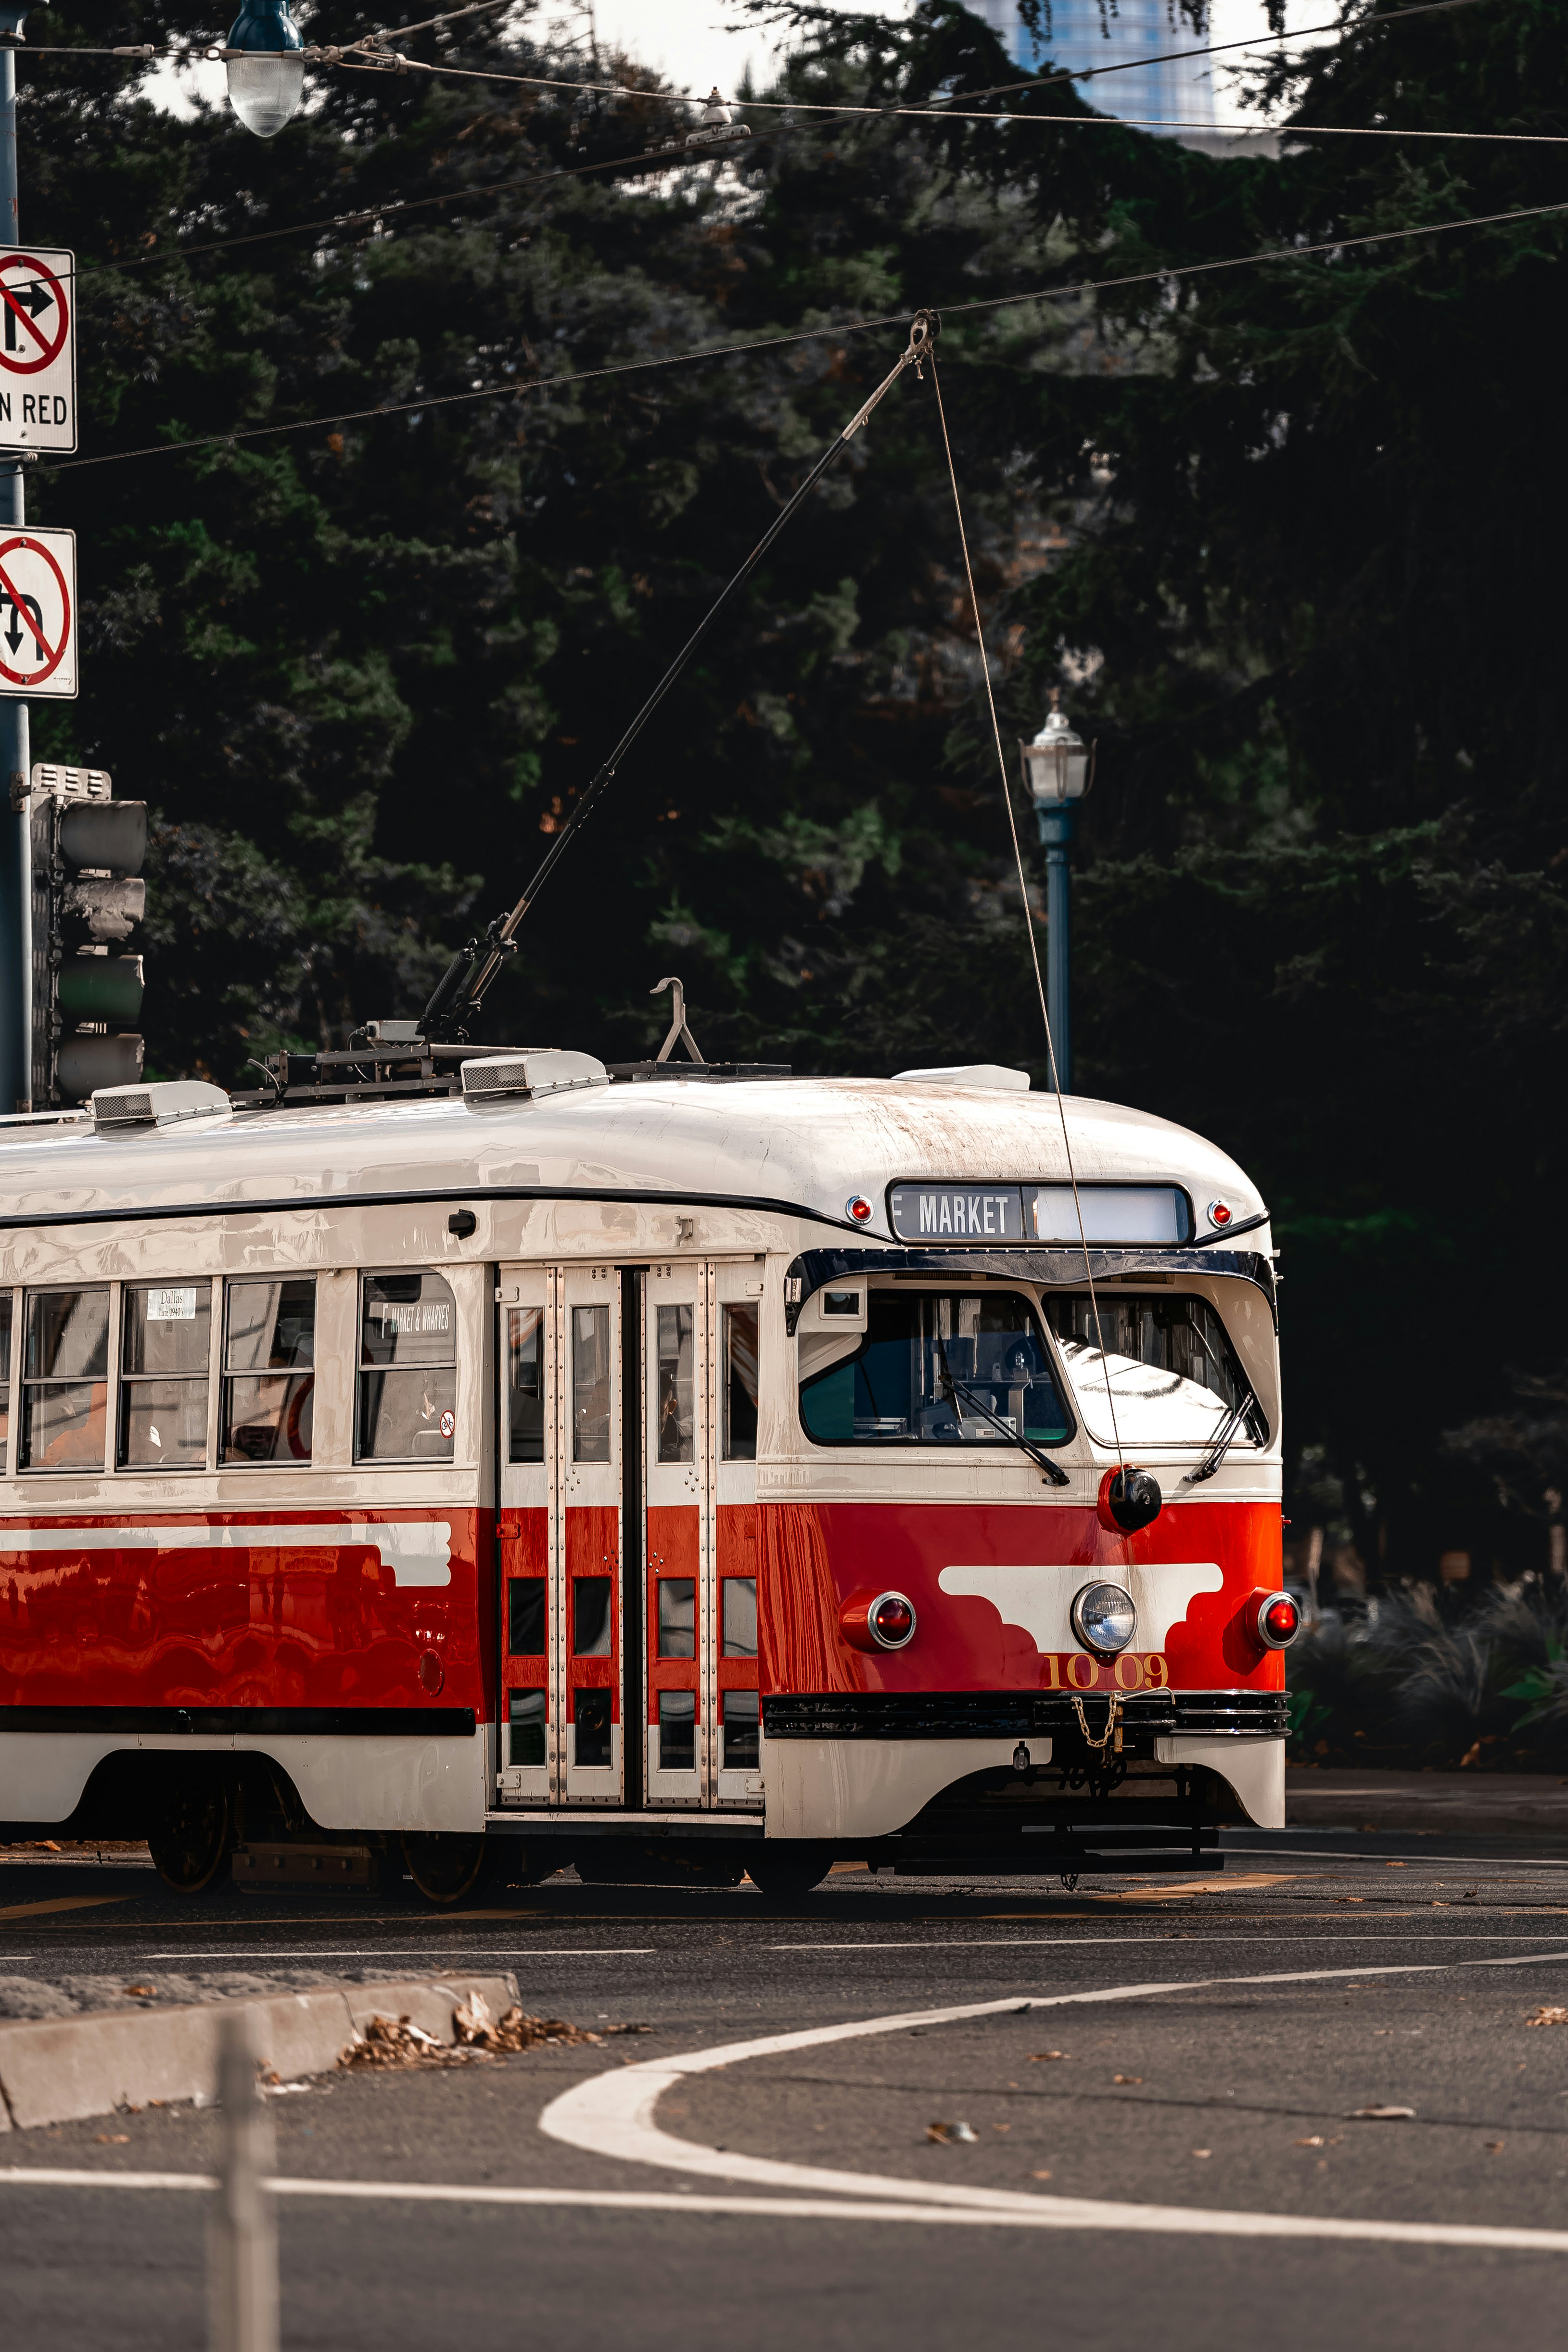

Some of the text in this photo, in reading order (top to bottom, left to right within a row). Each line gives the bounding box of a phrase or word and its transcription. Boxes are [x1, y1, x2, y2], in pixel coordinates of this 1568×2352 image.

[0, 393, 67, 425] N RED
[919, 1195, 1009, 1234] MARKET
[159, 1308, 184, 1317] Late 1940's
[161, 1290, 183, 1304] Dallas
[382, 1303, 449, 1339] F MARKET & WHARVES
